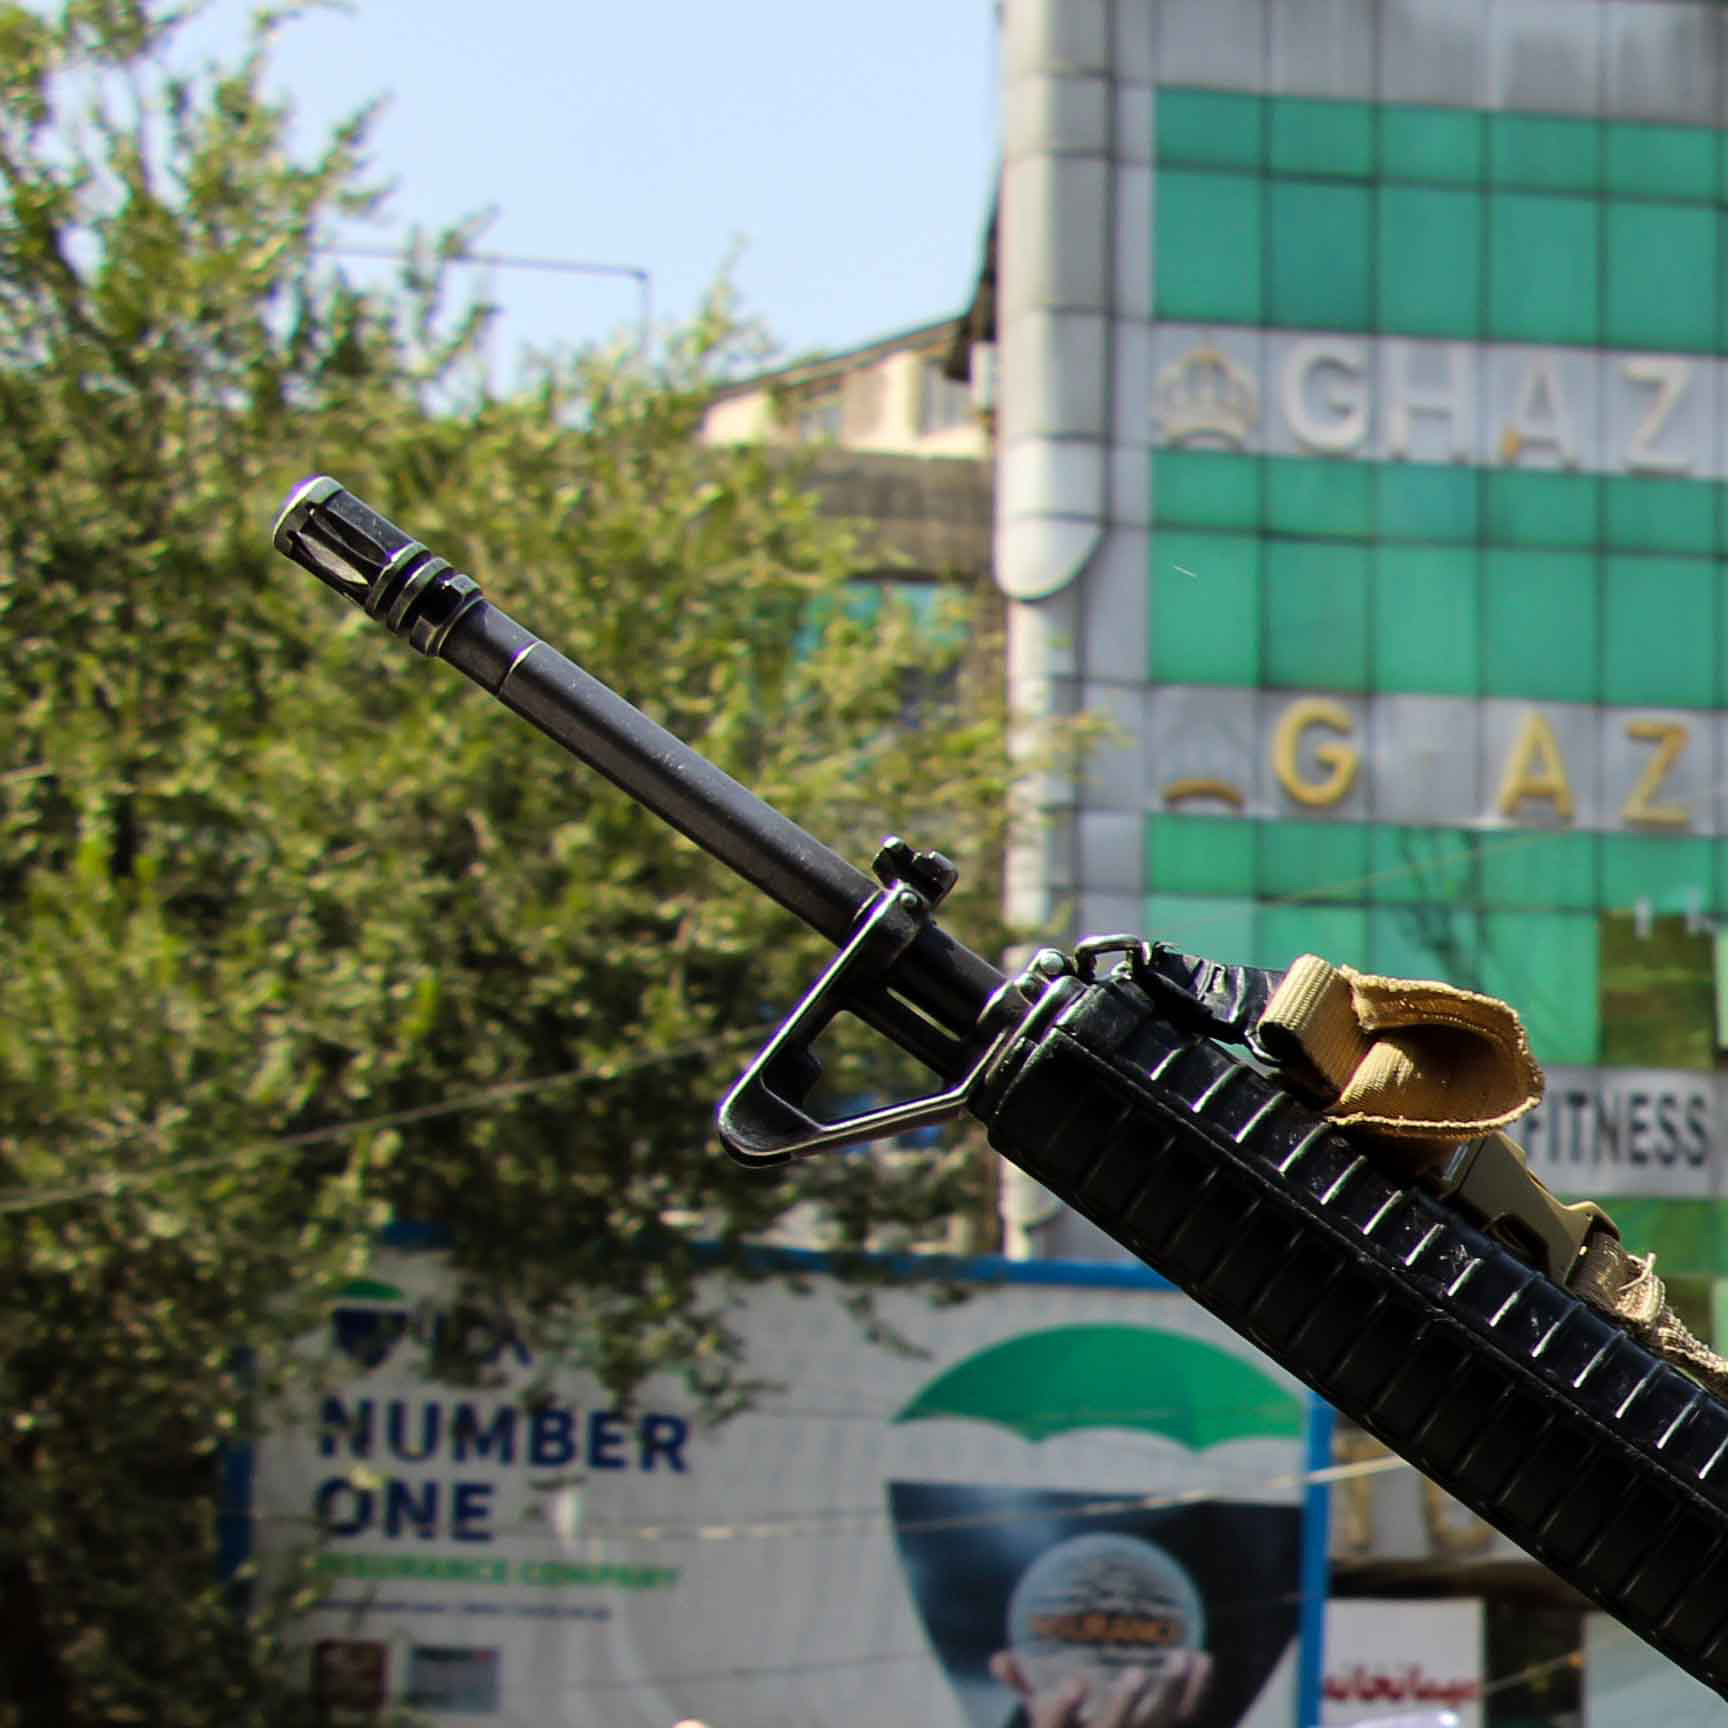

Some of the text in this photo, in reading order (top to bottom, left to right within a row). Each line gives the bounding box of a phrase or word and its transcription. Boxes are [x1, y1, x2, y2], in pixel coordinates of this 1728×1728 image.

[1521, 1092, 1708, 1166] FITNESS
[317, 1394, 690, 1474] NUMBER
[314, 1476, 496, 1543] ONE
